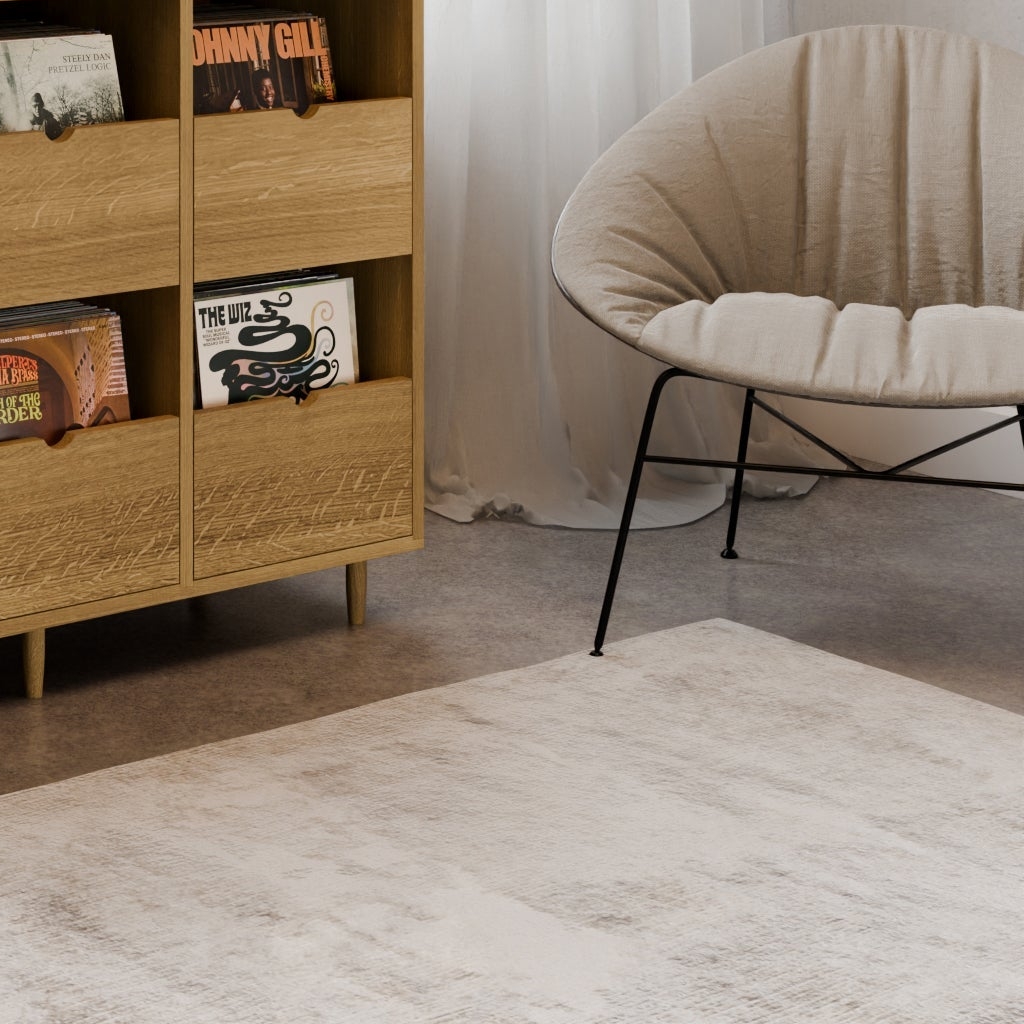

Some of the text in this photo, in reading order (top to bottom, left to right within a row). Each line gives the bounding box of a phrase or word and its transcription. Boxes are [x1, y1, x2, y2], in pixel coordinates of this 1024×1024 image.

[193, 18, 329, 66] OHNNY GILL
[62, 52, 111, 63] STEELY DAN
[48, 62, 112, 74] PRETZEL LOGIC
[198, 301, 252, 328] THE WIZ
[10, 367, 39, 387] BRASS
[5, 395, 18, 408] OF
[18, 391, 41, 407] THE
